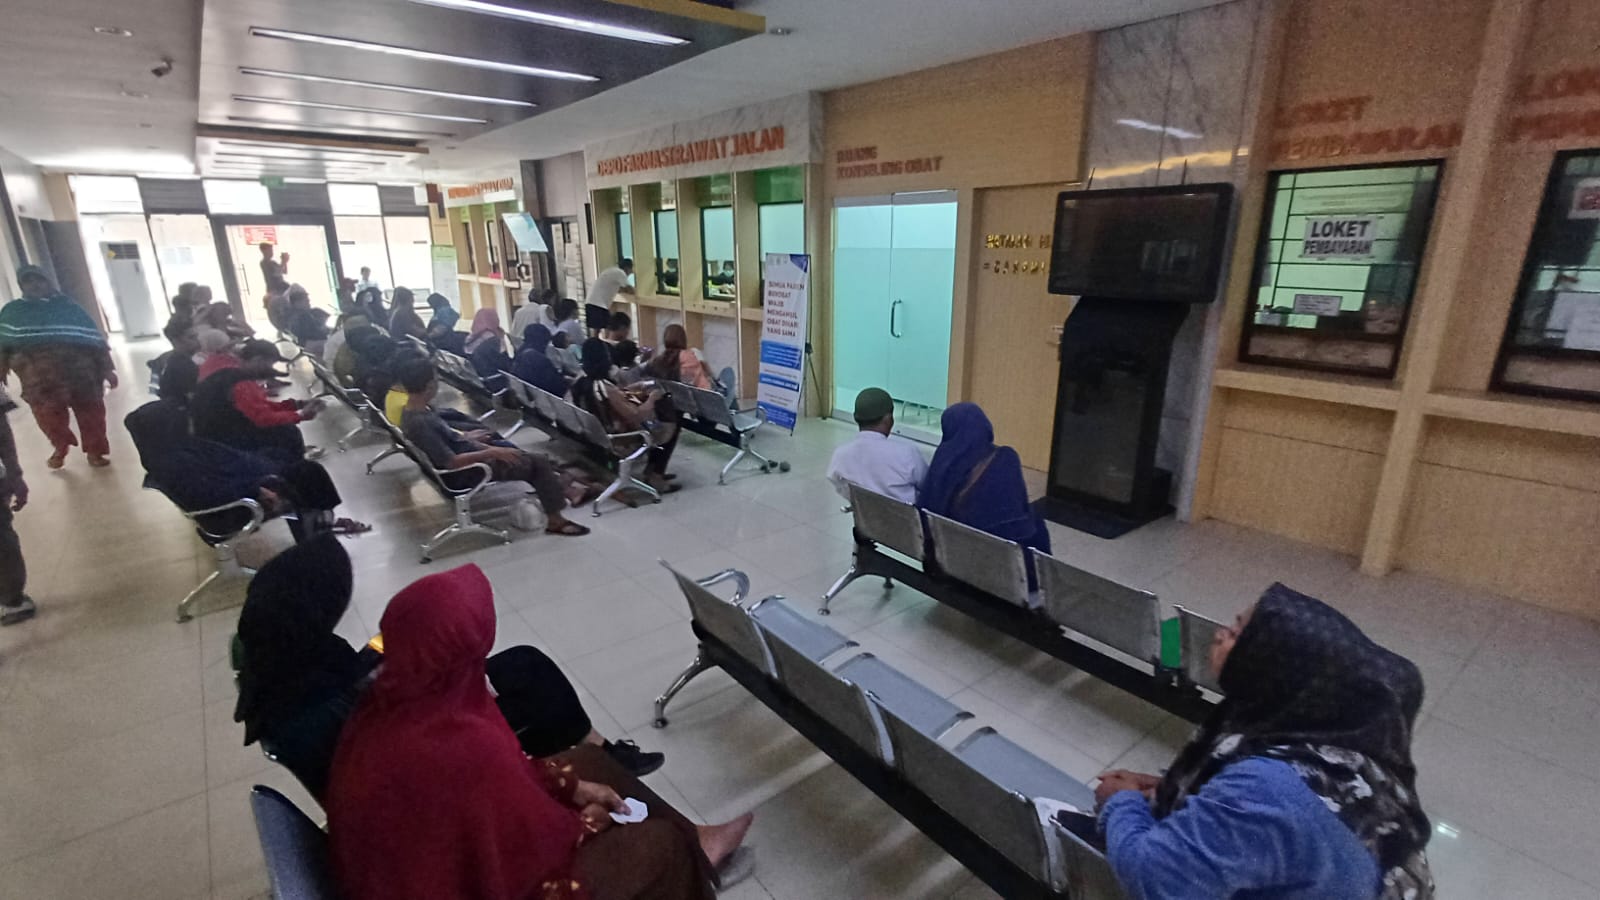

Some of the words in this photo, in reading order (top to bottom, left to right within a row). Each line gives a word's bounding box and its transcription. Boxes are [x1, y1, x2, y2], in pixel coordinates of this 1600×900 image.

[674, 136, 730, 166] RAWAT
[731, 126, 785, 157] JALAN
[904, 156, 943, 174] OBAT
[1310, 220, 1371, 238] LOKET
[1303, 239, 1373, 255] PEMBAYARAN
